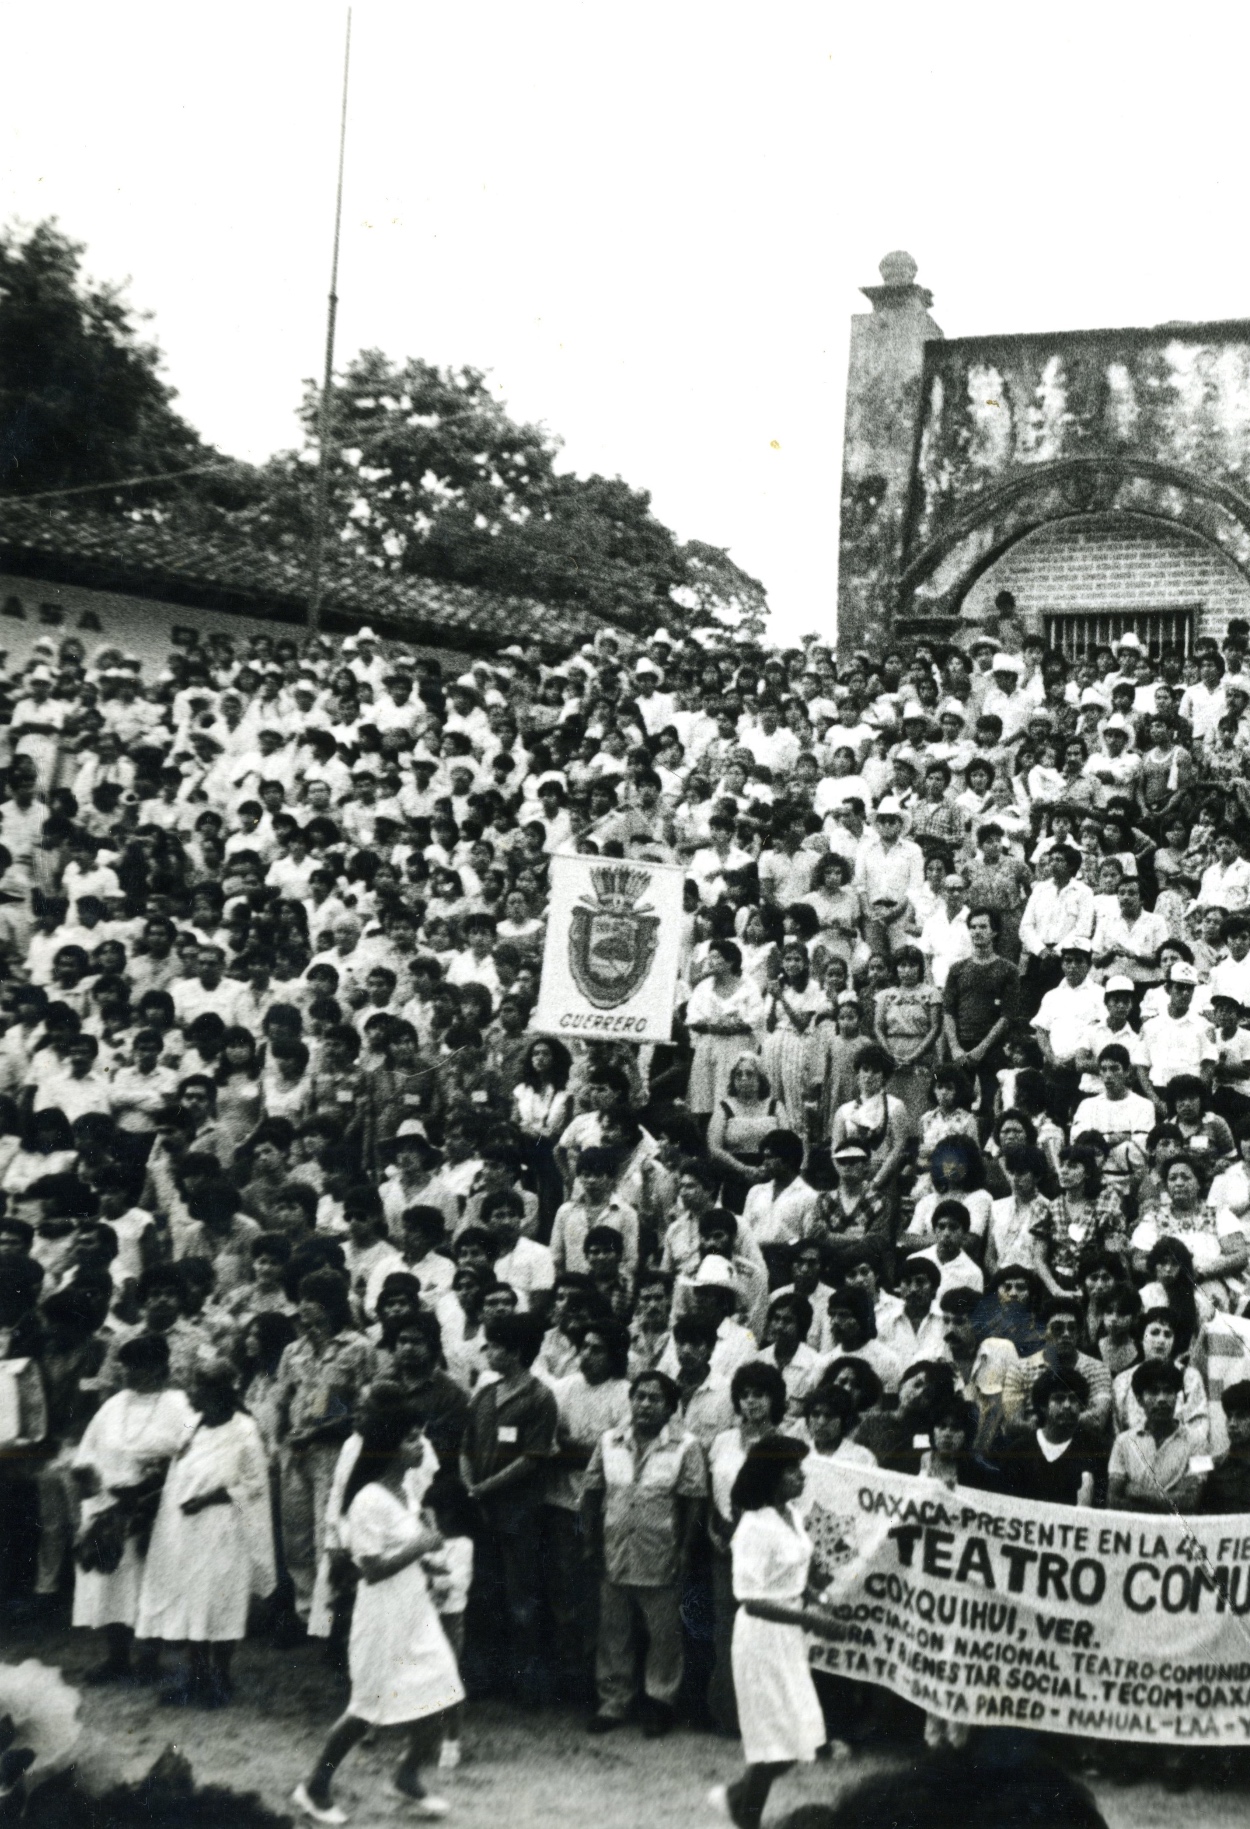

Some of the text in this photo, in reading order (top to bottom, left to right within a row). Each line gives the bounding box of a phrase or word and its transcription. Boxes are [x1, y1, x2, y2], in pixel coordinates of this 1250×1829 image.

[559, 1012, 648, 1033] GUERRERO
[1098, 1529, 1131, 1554] EN
[1139, 1533, 1169, 1559] LA
[888, 1524, 1106, 1606] TEATRO
[1036, 1612, 1101, 1649] VER.
[954, 1636, 1060, 1672] NACIONAL
[976, 1693, 1045, 1720] PARED
